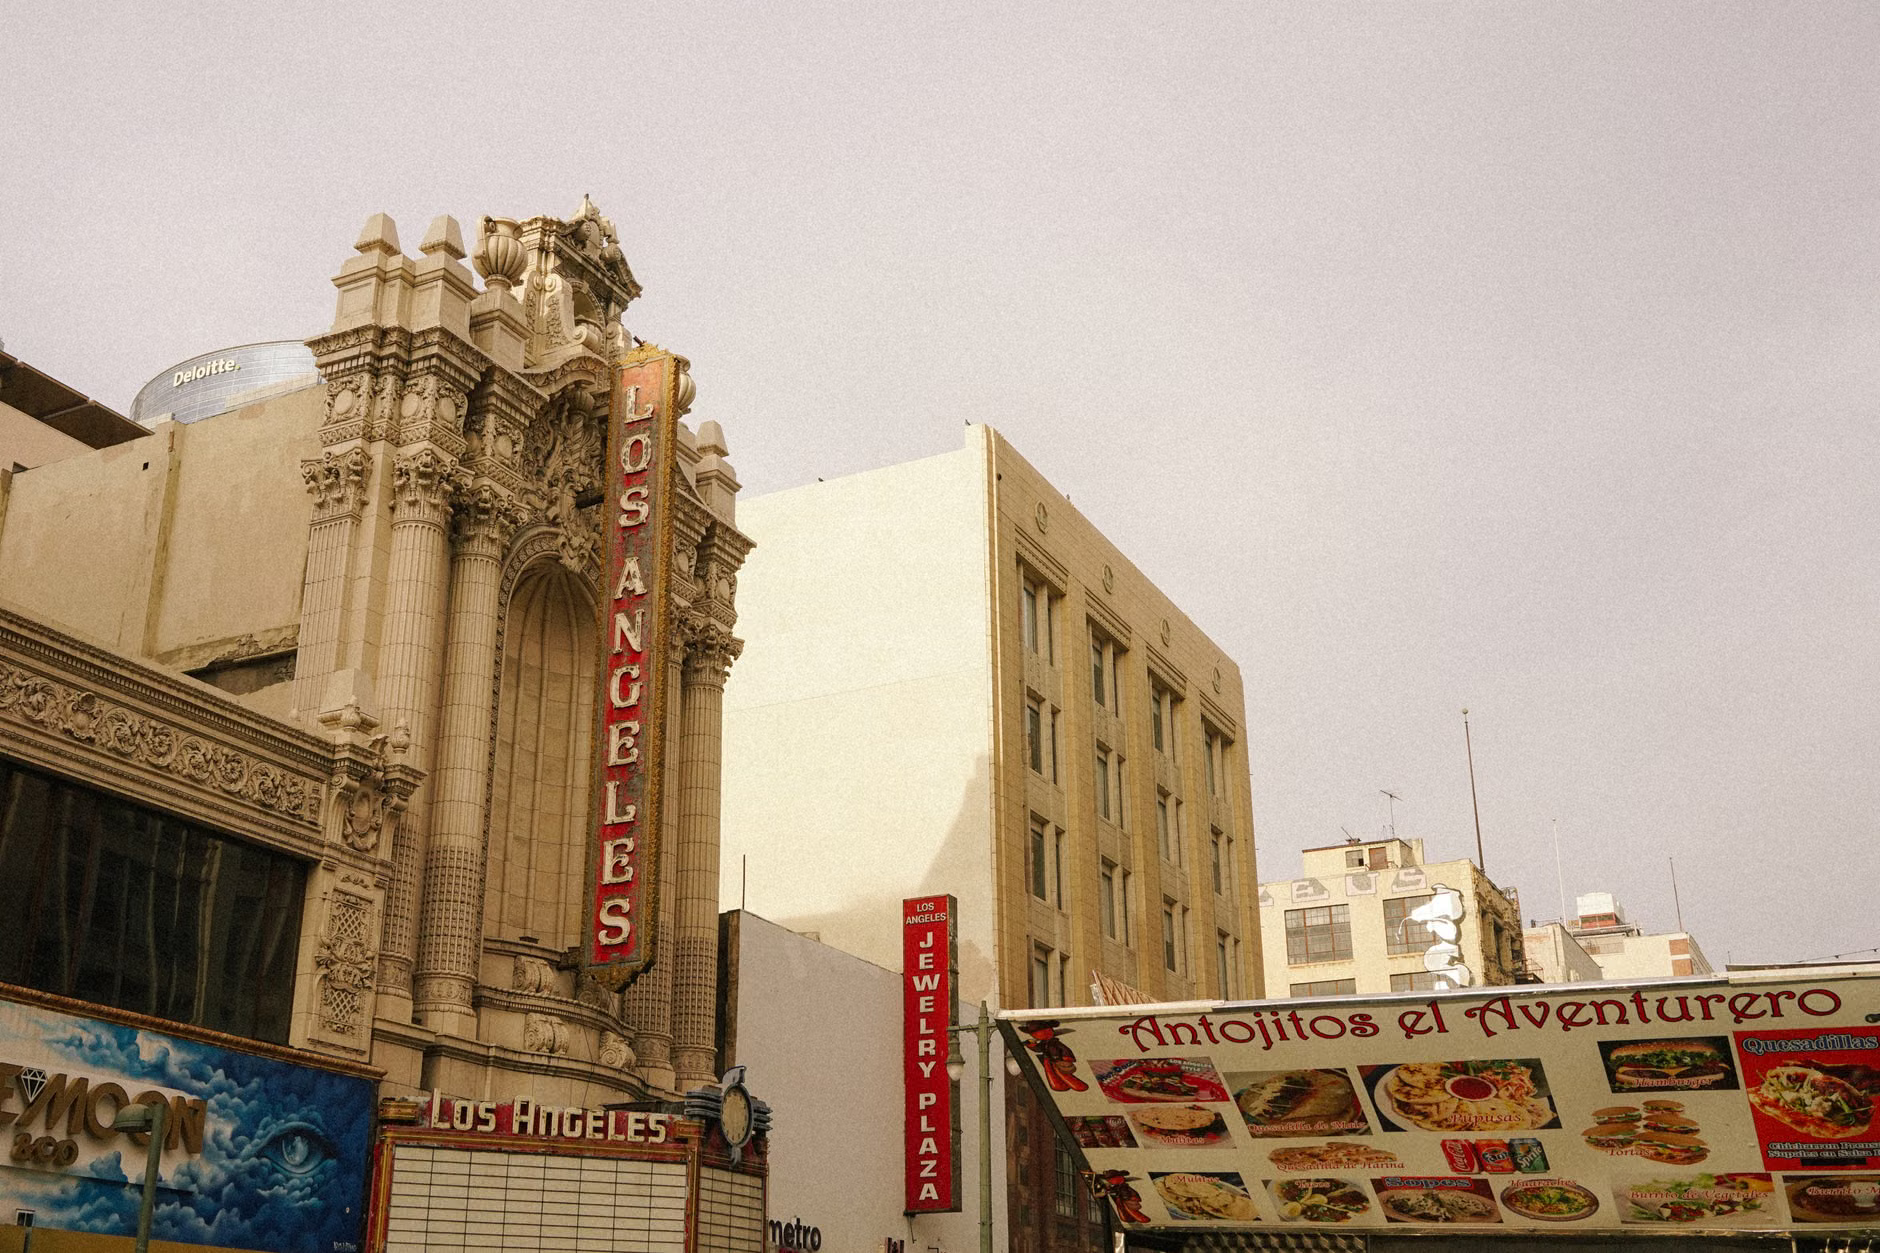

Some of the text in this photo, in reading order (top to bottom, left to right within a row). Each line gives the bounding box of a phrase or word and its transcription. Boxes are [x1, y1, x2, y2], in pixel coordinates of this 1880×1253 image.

[598, 384, 654, 946] LOS ANGELES
[916, 902, 935, 912] LOS
[905, 912, 946, 924] ANGELES
[1118, 988, 1842, 1053] Antojitos el Aventurero
[1742, 1033, 1879, 1056] Quesadillas
[912, 931, 941, 1200] JEWELRY PLAZA
[1632, 1076, 1714, 1089] Hamburger
[431, 1087, 497, 1133] LOS
[1447, 1111, 1523, 1127] Pupusas
[1249, 1120, 1313, 1134] Quesadilla
[1313, 1120, 1330, 1131] de
[1516, 1145, 1543, 1169] Sprite
[1606, 1148, 1650, 1157] Tortas
[1276, 1162, 1342, 1172] Quesadilla
[1342, 1161, 1359, 1170] de
[1384, 1176, 1473, 1190] Sopes
[1508, 1177, 1577, 1188] Huaraches
[1629, 1190, 1769, 1201] Burrito de Vegetales
[768, 1217, 822, 1251] metro
